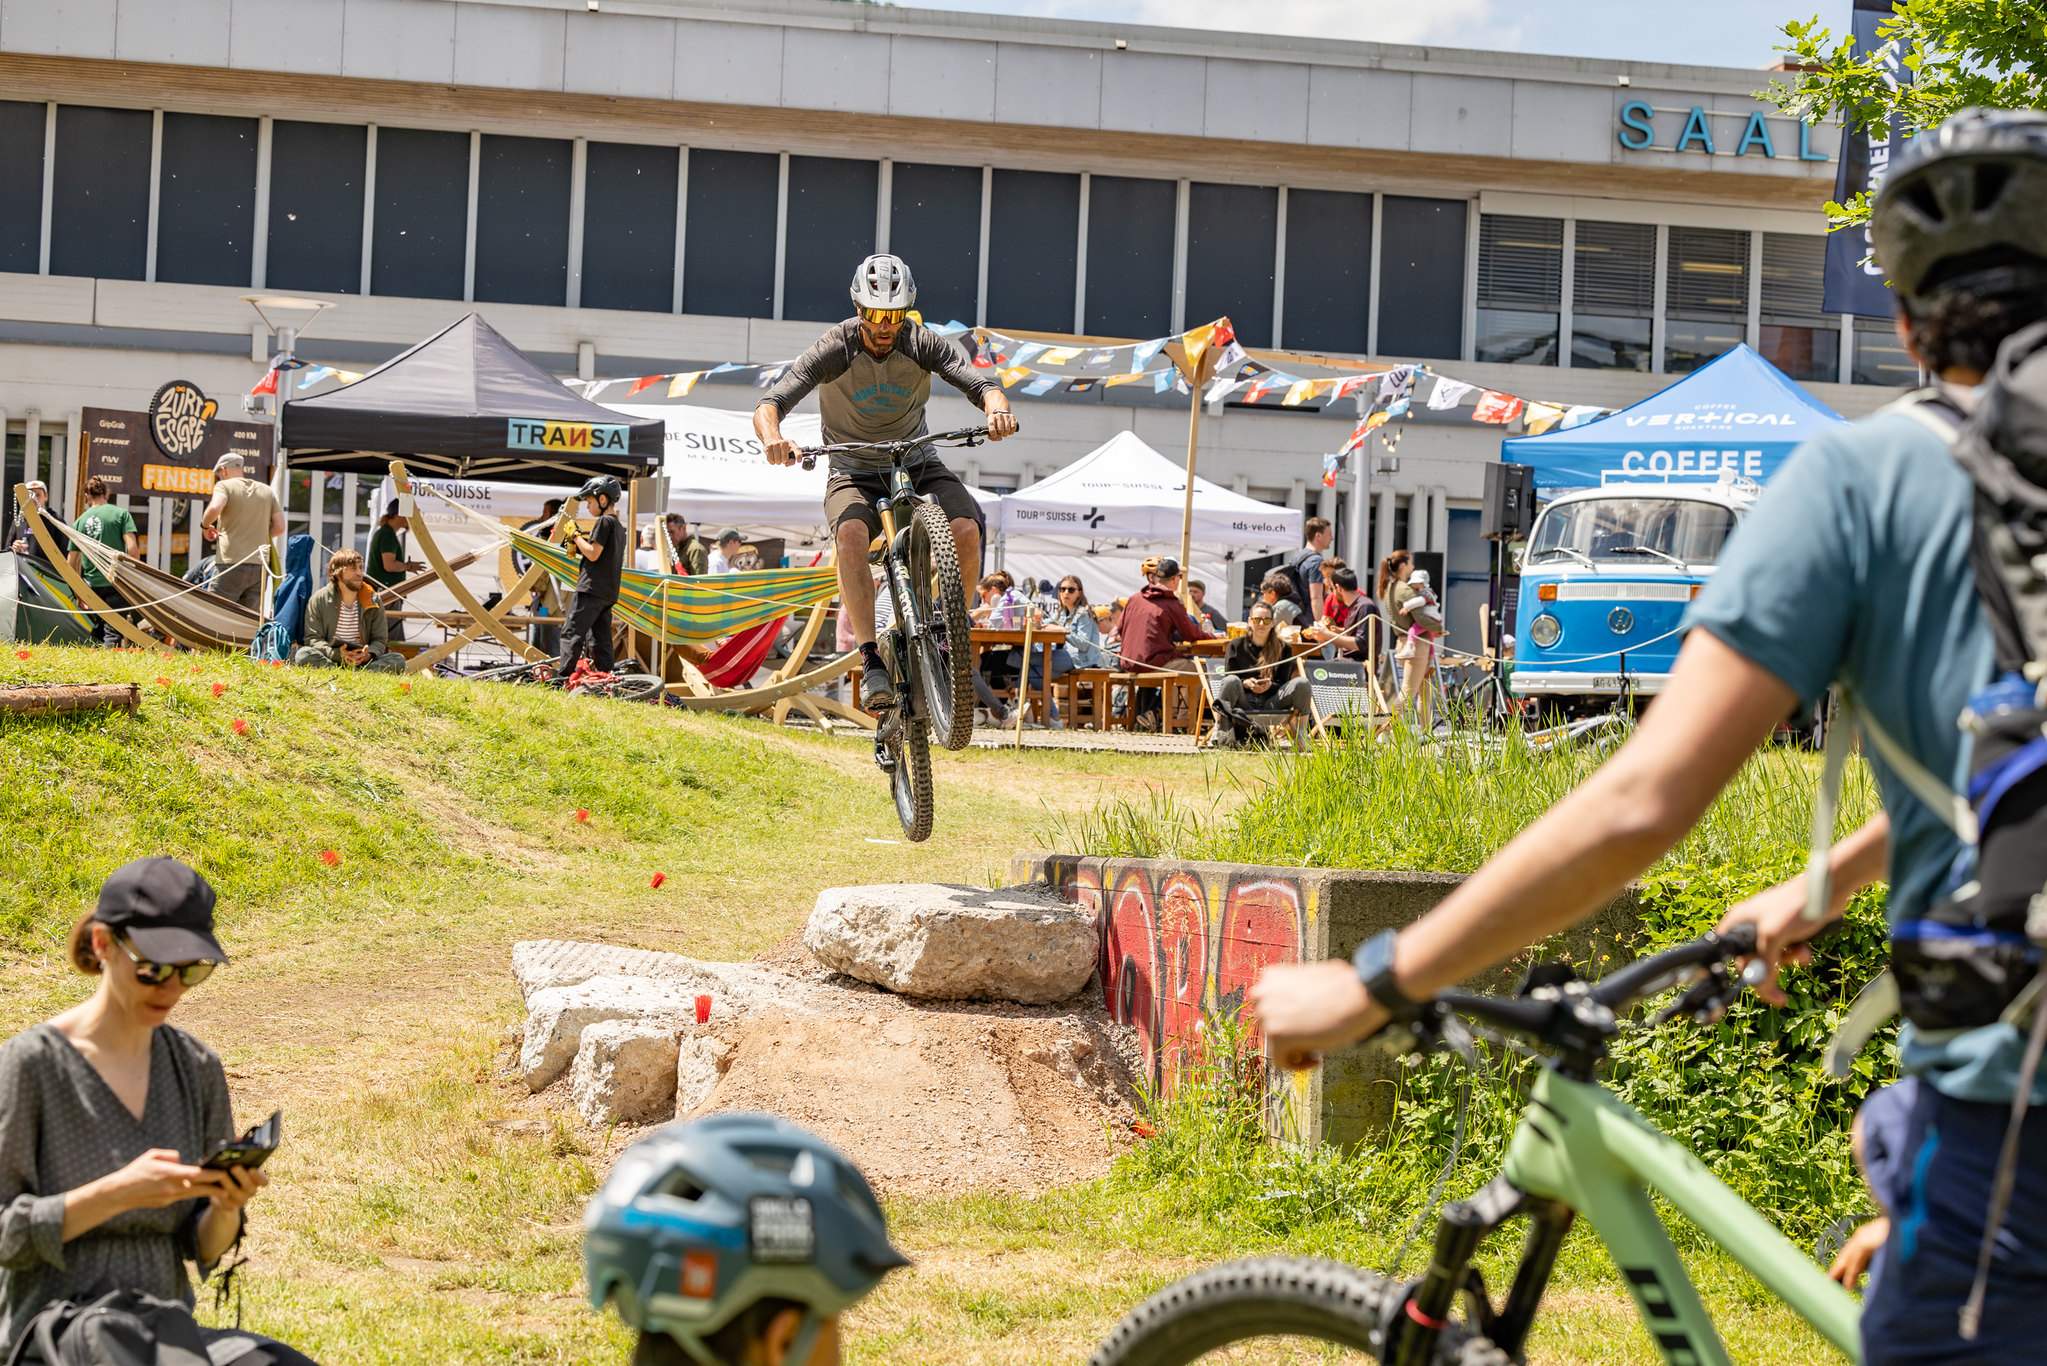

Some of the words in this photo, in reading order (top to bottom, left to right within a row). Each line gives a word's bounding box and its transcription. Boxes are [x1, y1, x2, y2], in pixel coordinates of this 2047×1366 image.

[1618, 100, 1829, 161] SAAL
[246, 432, 257, 440] KM
[685, 432, 762, 456] SUISS
[1622, 450, 1763, 476] COFFEE
[145, 467, 213, 492] FINISH
[446, 484, 491, 500] SUISSE
[1016, 509, 1039, 520] TOUR
[1046, 511, 1077, 522] SUISSE
[1232, 520, 1286, 533] tds-velo.ch
[1328, 671, 1358, 680] komoot
